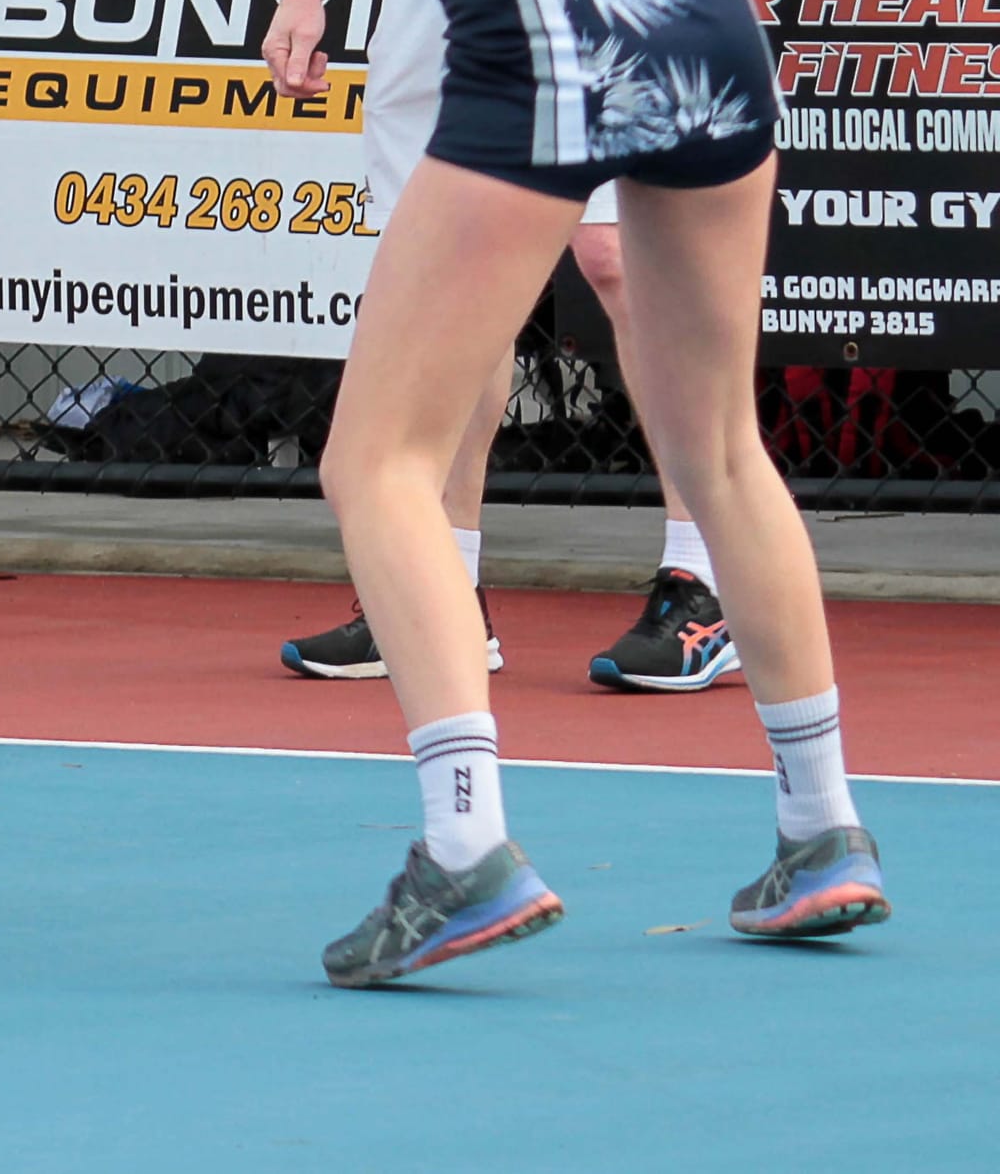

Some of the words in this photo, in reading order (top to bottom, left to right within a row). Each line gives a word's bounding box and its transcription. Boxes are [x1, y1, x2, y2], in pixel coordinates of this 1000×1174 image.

[832, 108, 910, 151] LOCAL
[916, 109, 1000, 152] COMM
[55, 172, 178, 227] 0434
[186, 177, 283, 232] 268
[777, 189, 917, 227] YOUR
[783, 276, 854, 300] GOON
[762, 309, 865, 333] BUNYIP
[870, 311, 935, 335] 3815
